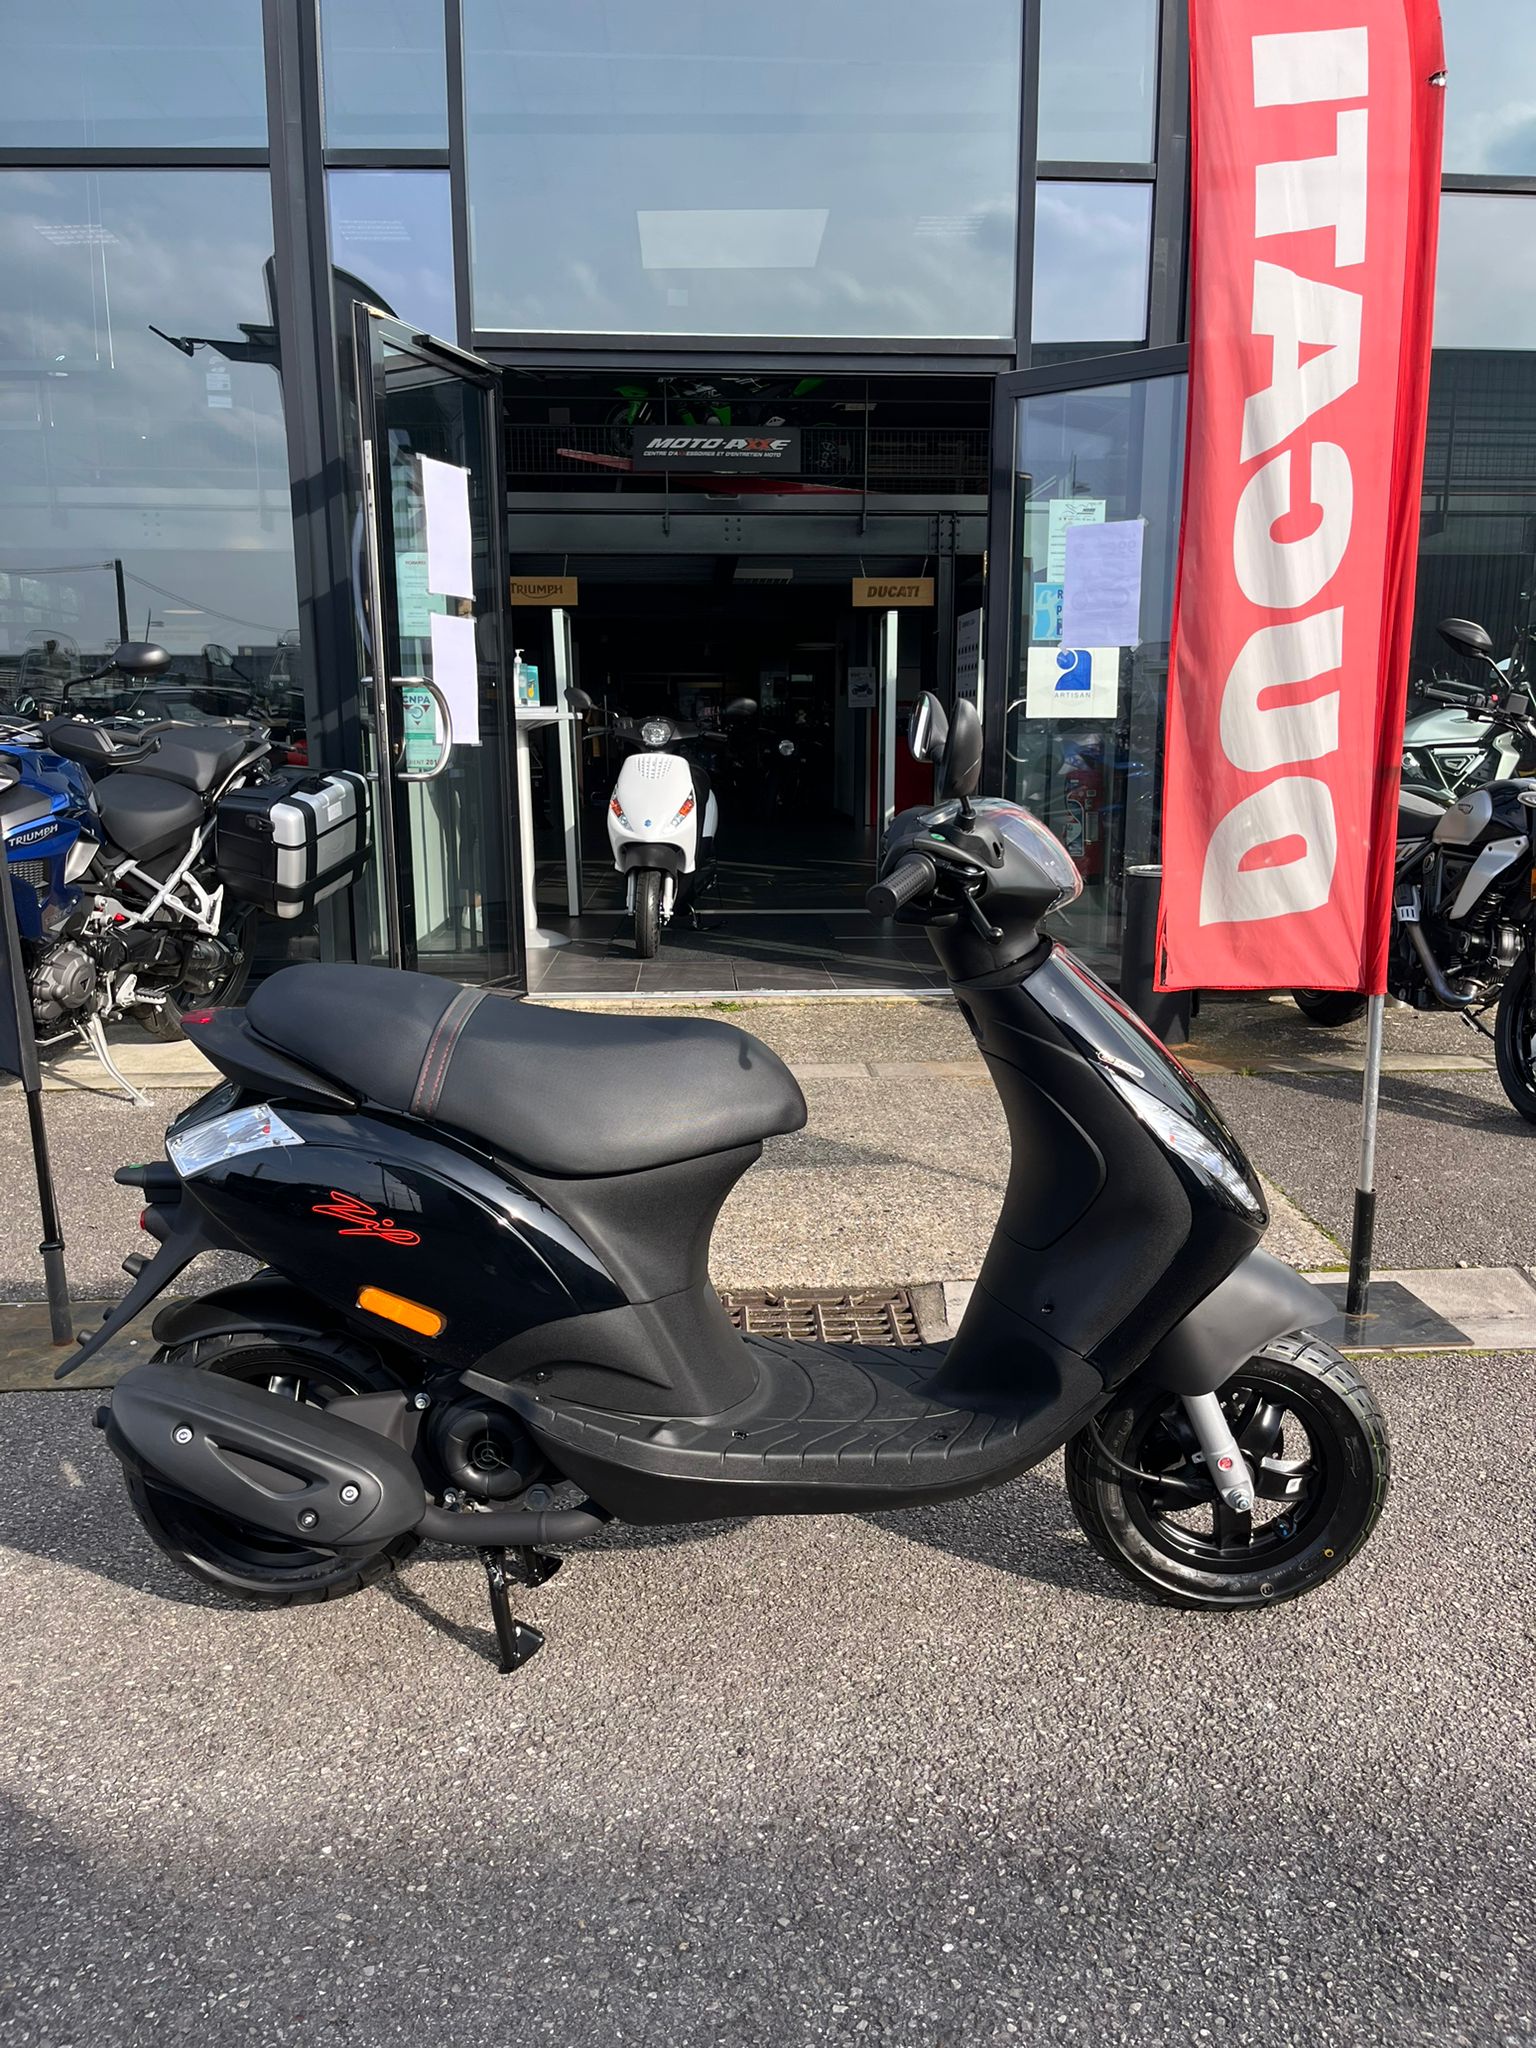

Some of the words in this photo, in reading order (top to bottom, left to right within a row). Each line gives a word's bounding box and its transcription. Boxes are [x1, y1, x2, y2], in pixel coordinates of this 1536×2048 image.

[510, 583, 563, 597] TRIUMPH
[867, 586, 920, 598] DUCATI
[402, 696, 431, 704] CNPA
[9, 824, 59, 847] TRIUMPH
